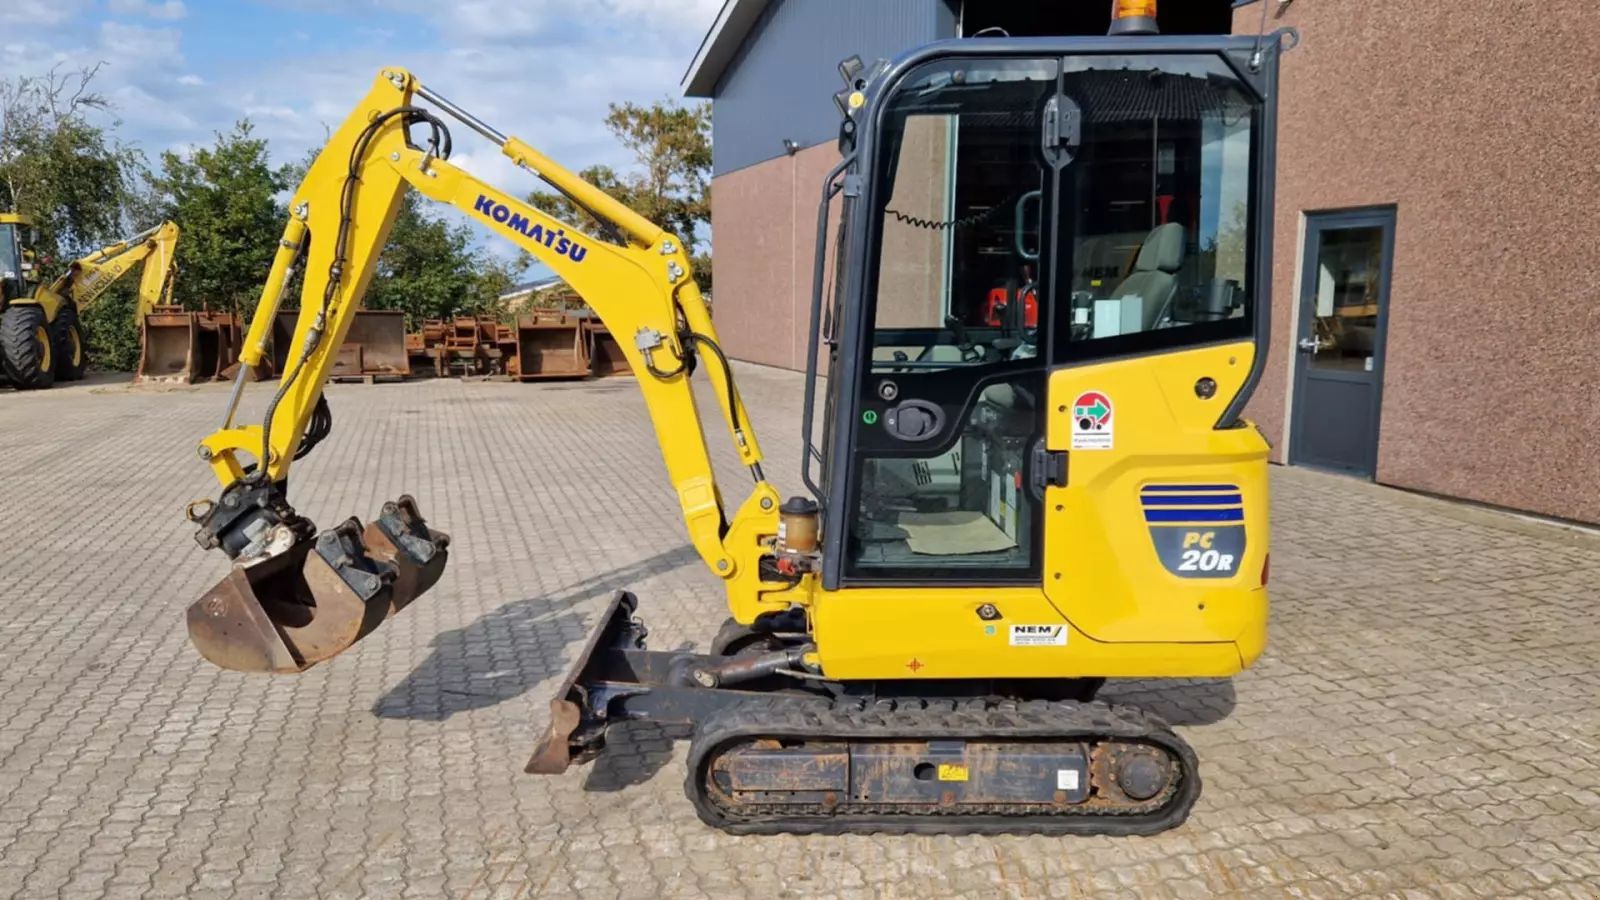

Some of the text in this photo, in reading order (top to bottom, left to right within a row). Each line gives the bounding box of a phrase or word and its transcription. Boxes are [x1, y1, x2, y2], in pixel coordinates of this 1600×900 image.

[474, 194, 588, 263] KOMATSU
[1182, 531, 1216, 549] PC
[1178, 549, 1234, 571] 20R
